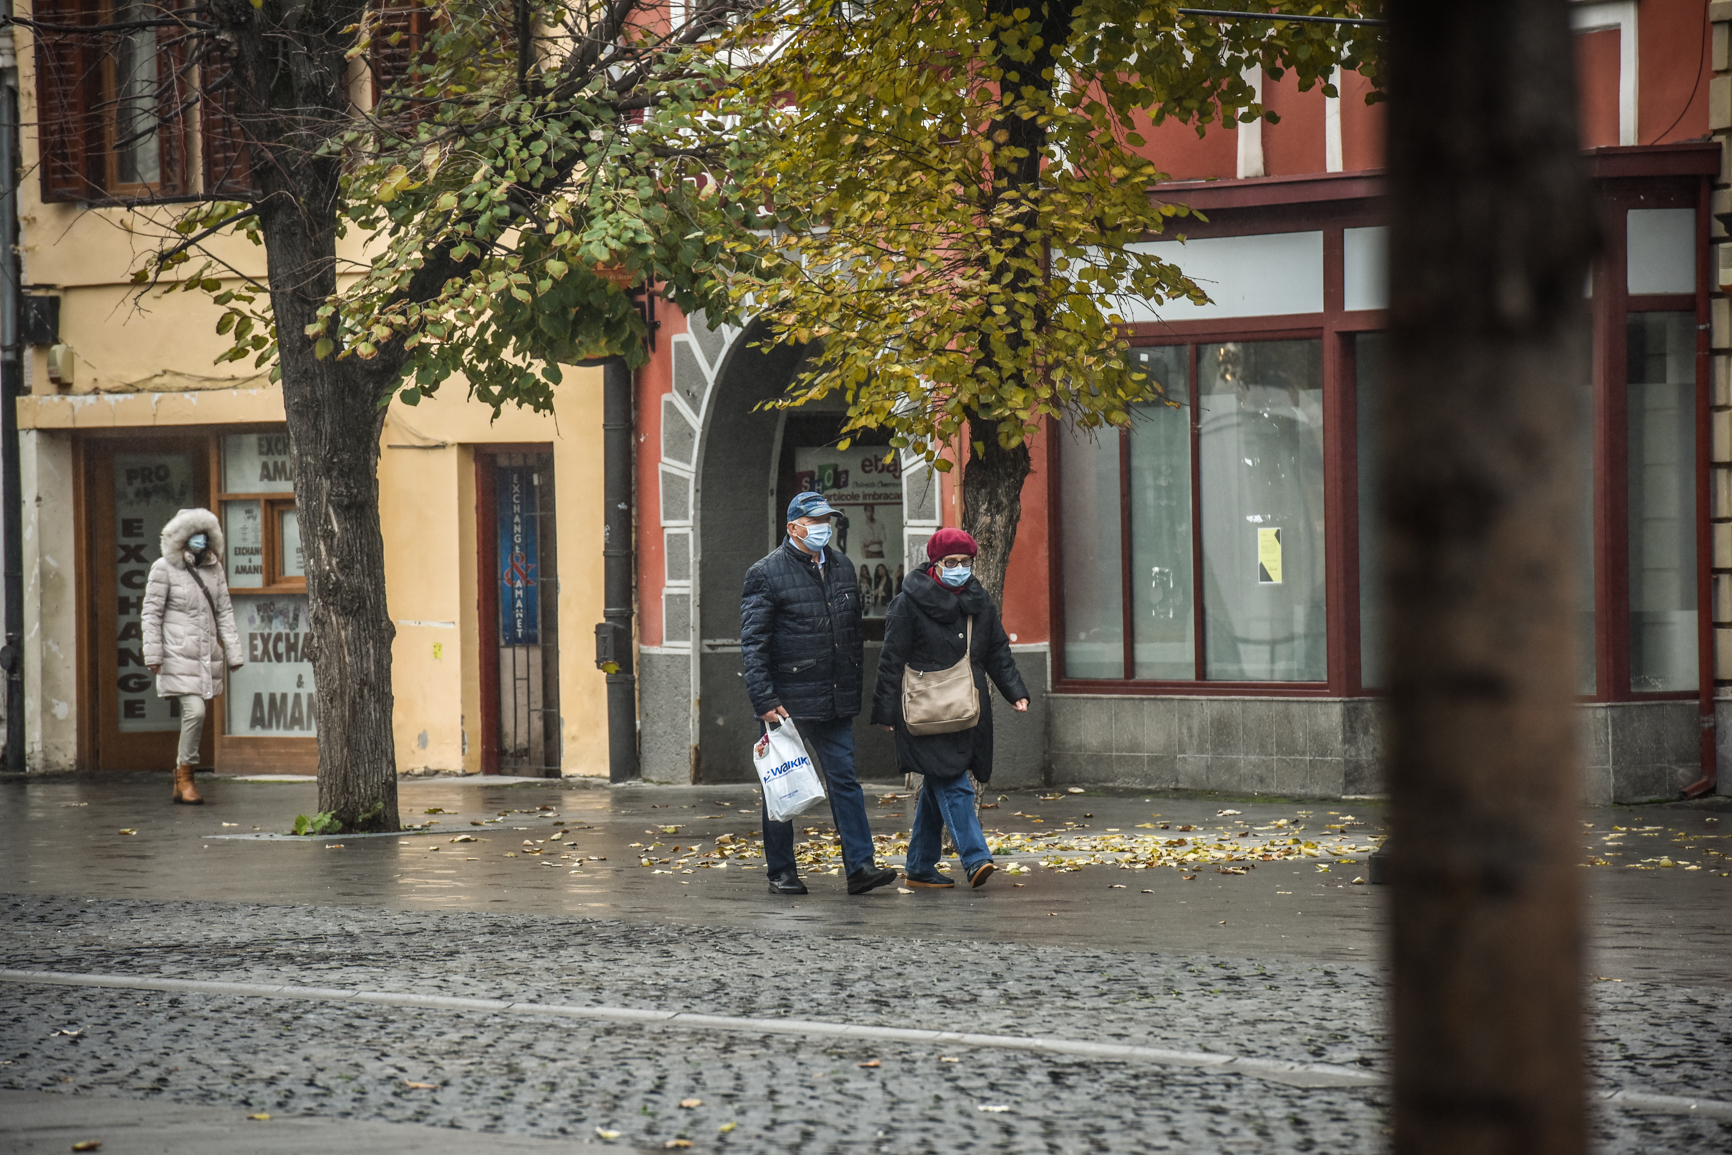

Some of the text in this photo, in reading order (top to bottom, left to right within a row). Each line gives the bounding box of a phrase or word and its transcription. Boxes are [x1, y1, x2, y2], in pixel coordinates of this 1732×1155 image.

[126, 464, 170, 486] PRO
[802, 469, 847, 493] SHOP
[825, 491, 860, 502] articole
[512, 474, 522, 554] EXCHANGE
[504, 551, 536, 587] &
[117, 518, 151, 719] EXCHANGE
[514, 579, 524, 639] AMANET
[296, 673, 305, 689] &
